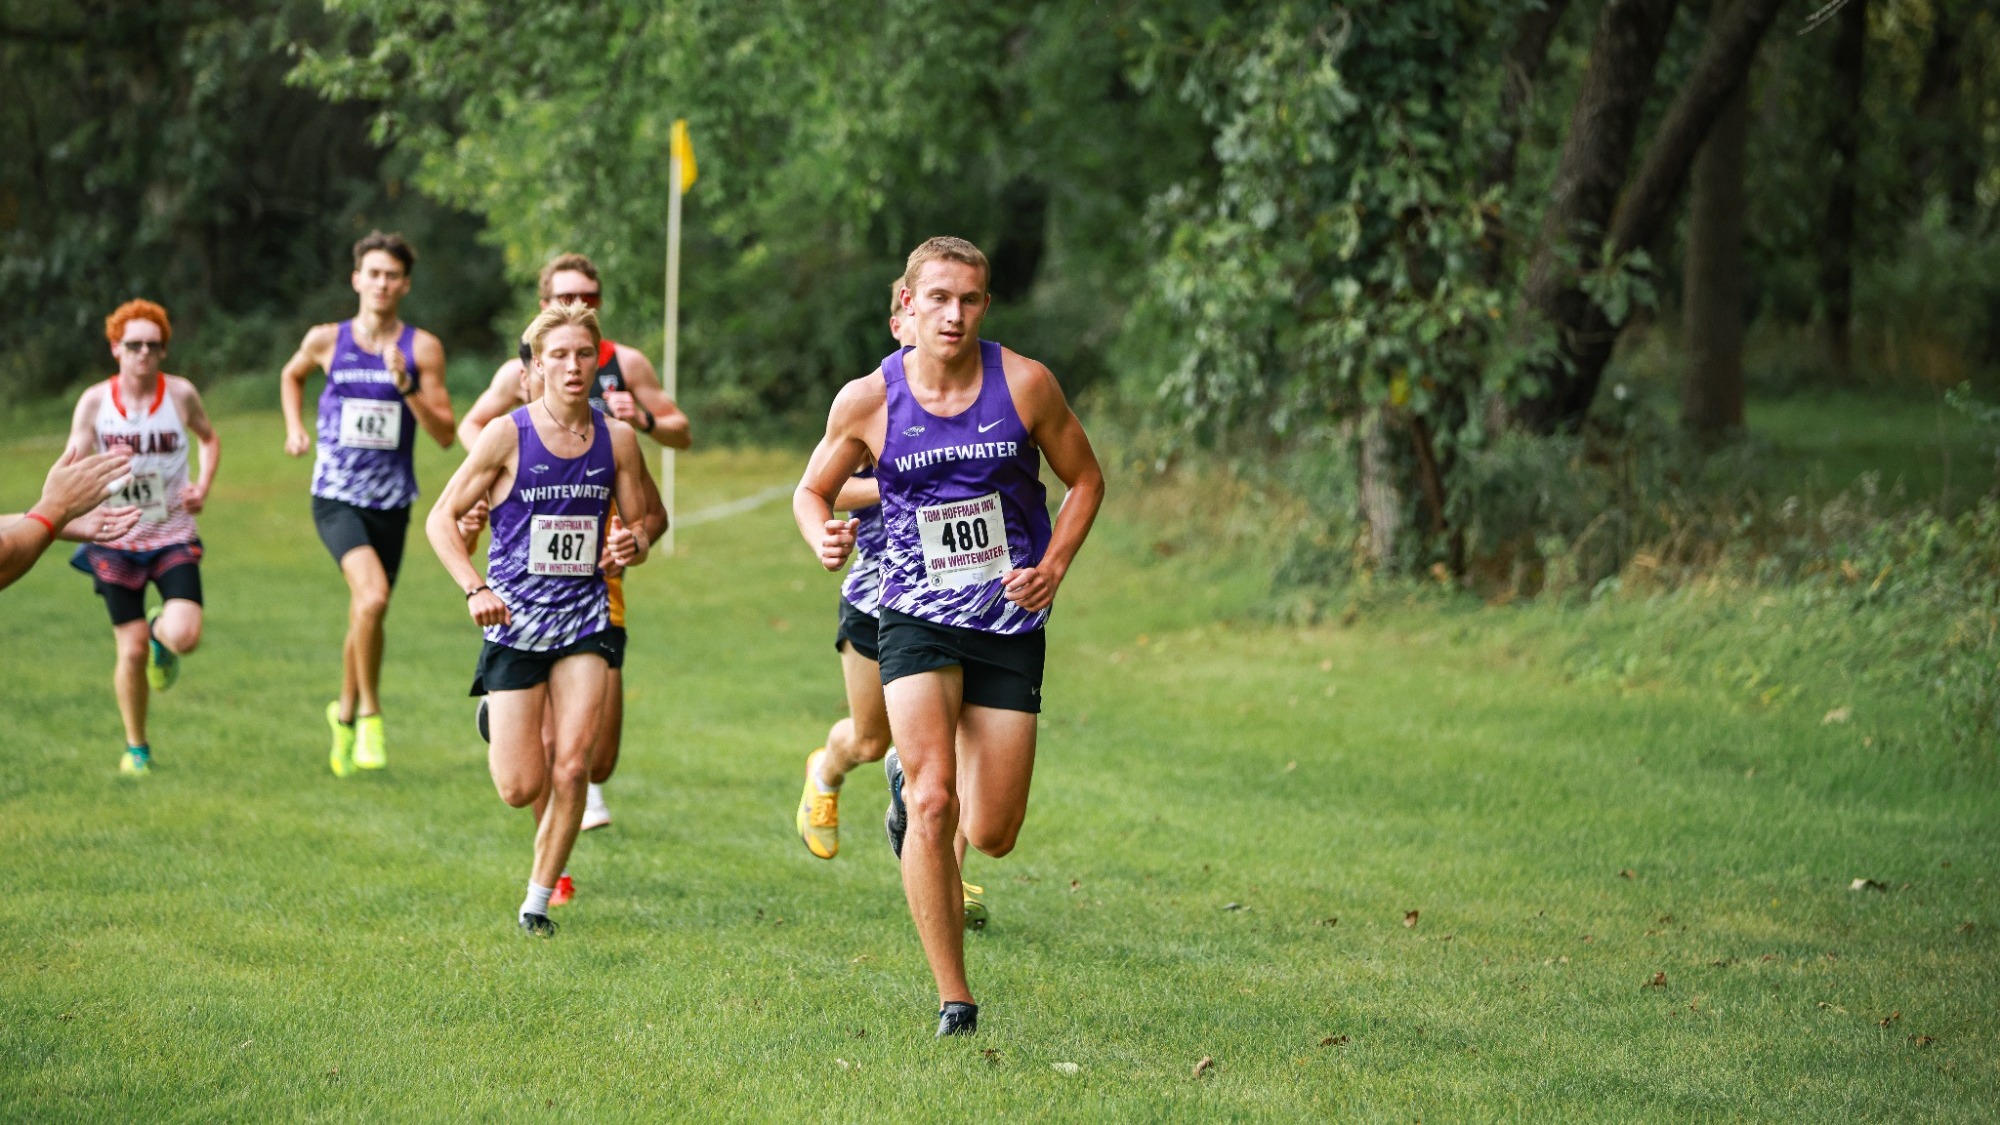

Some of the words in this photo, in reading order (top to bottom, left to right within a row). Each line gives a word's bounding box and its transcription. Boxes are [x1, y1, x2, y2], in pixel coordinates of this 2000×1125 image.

[895, 441, 1017, 472] WHITEWATER
[923, 509, 940, 523] TOM
[941, 502, 980, 520] HOFFMAN
[981, 499, 996, 512] INV.
[538, 519, 552, 530] TOM
[554, 520, 582, 530] HOFFMAN
[942, 518, 988, 553] 480
[548, 533, 584, 560] 487
[930, 557, 946, 570] UW
[947, 545, 1004, 568] WHITEWATER
[534, 562, 546, 573] UW
